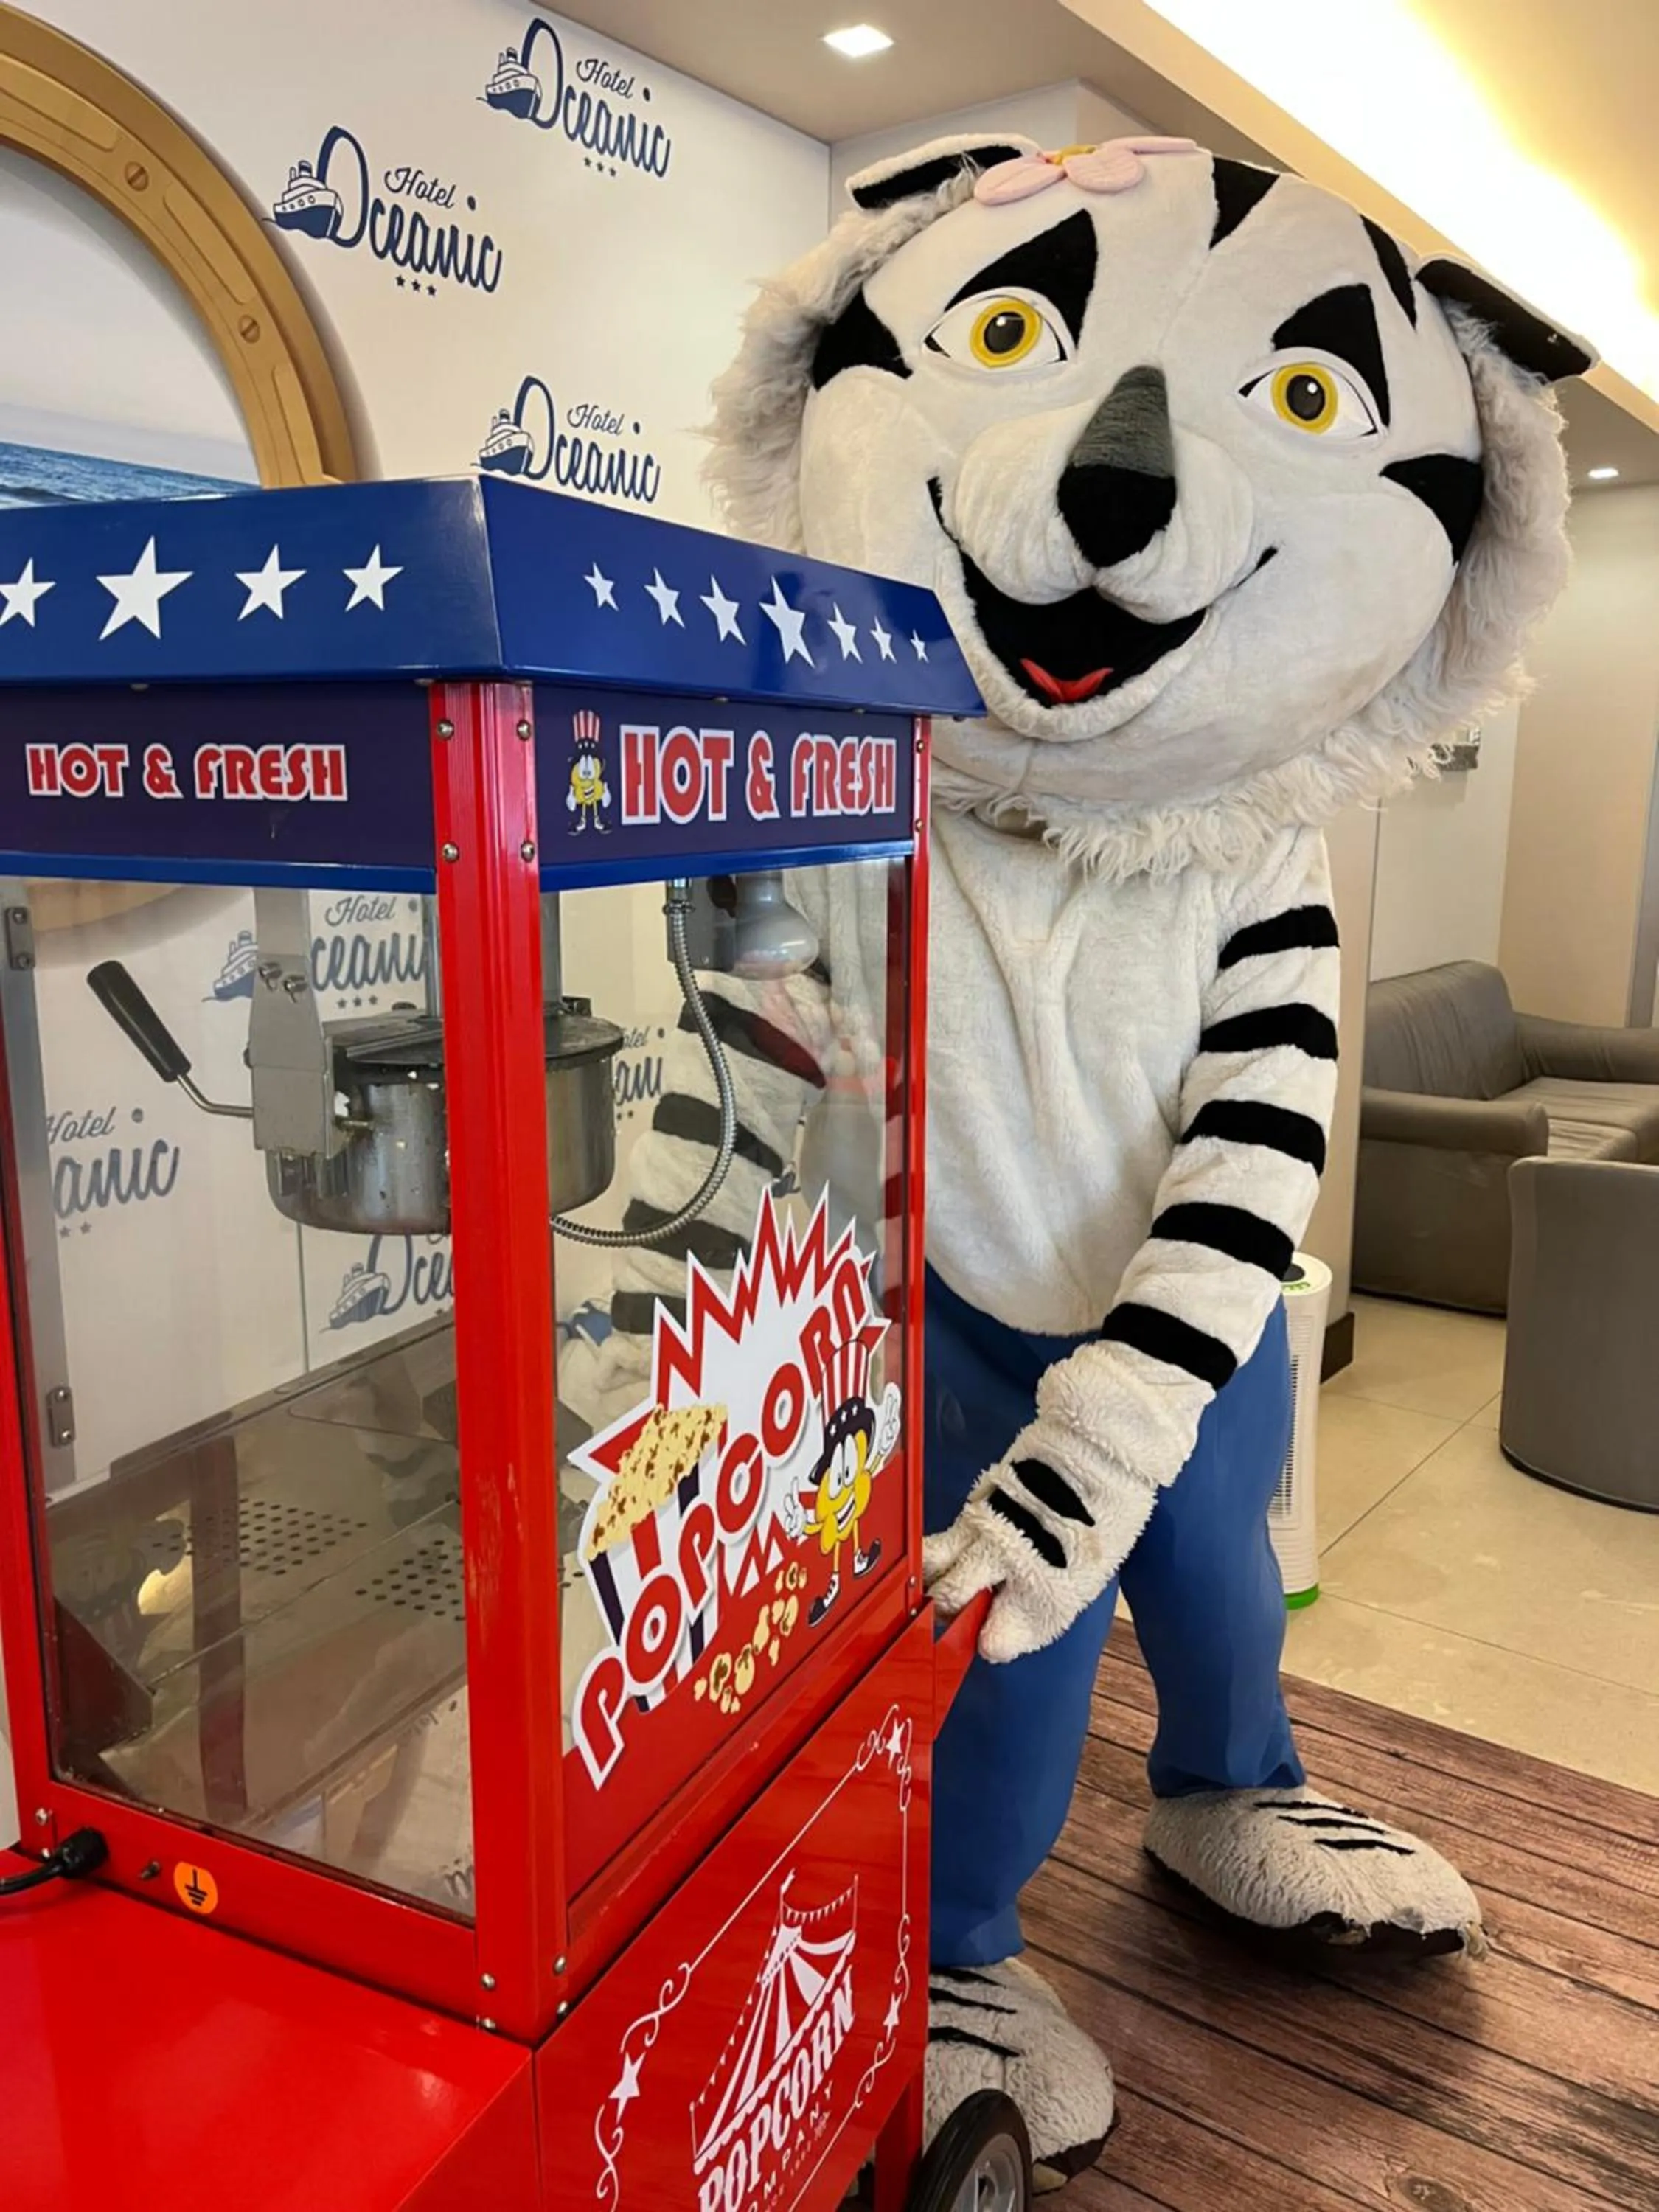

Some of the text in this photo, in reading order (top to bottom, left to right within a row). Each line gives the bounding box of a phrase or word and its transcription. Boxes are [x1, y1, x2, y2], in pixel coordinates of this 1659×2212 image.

[520, 18, 671, 178] Oceanic
[577, 58, 633, 99] Hotel
[316, 125, 503, 293] Oceanic
[383, 167, 456, 209] Hotel
[513, 375, 661, 503] Oceanic
[567, 404, 624, 435] Hotel
[26, 742, 348, 801] HOT & FRESH
[620, 724, 897, 825] HOT & FRESH
[311, 897, 426, 991] ceani
[325, 895, 397, 927] Hotel
[52, 1108, 180, 1218] anic
[574, 1249, 871, 1792] POPCORN
[697, 1966, 856, 2212] POPCORN
